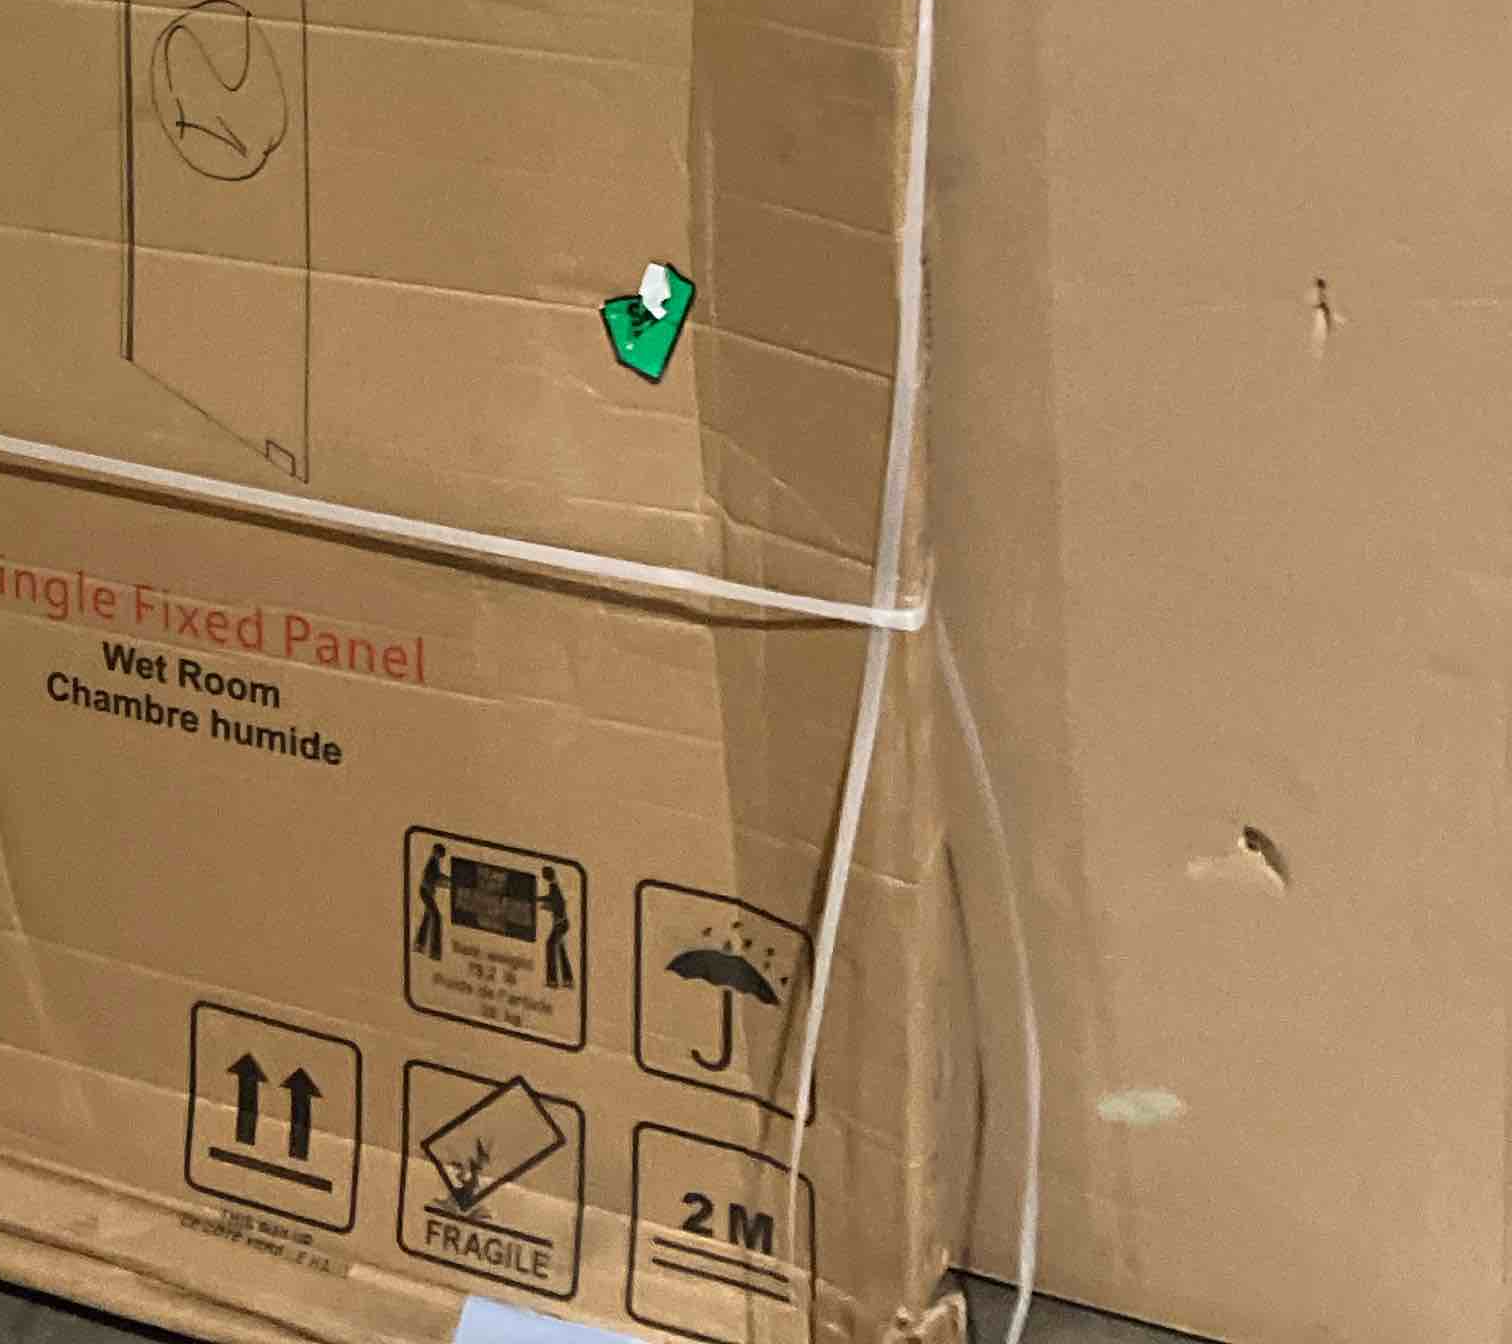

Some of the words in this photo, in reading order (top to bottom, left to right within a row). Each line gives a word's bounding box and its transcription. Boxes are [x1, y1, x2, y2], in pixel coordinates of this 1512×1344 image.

[134, 584, 265, 652] Fixed
[286, 614, 426, 683] Panel
[102, 641, 167, 683] Wet
[179, 658, 280, 709] Room
[47, 671, 199, 733] Chambre
[210, 710, 343, 767] humide
[425, 1218, 554, 1279] FRAGILE
[681, 1192, 714, 1236] 2
[729, 1203, 774, 1254] M
